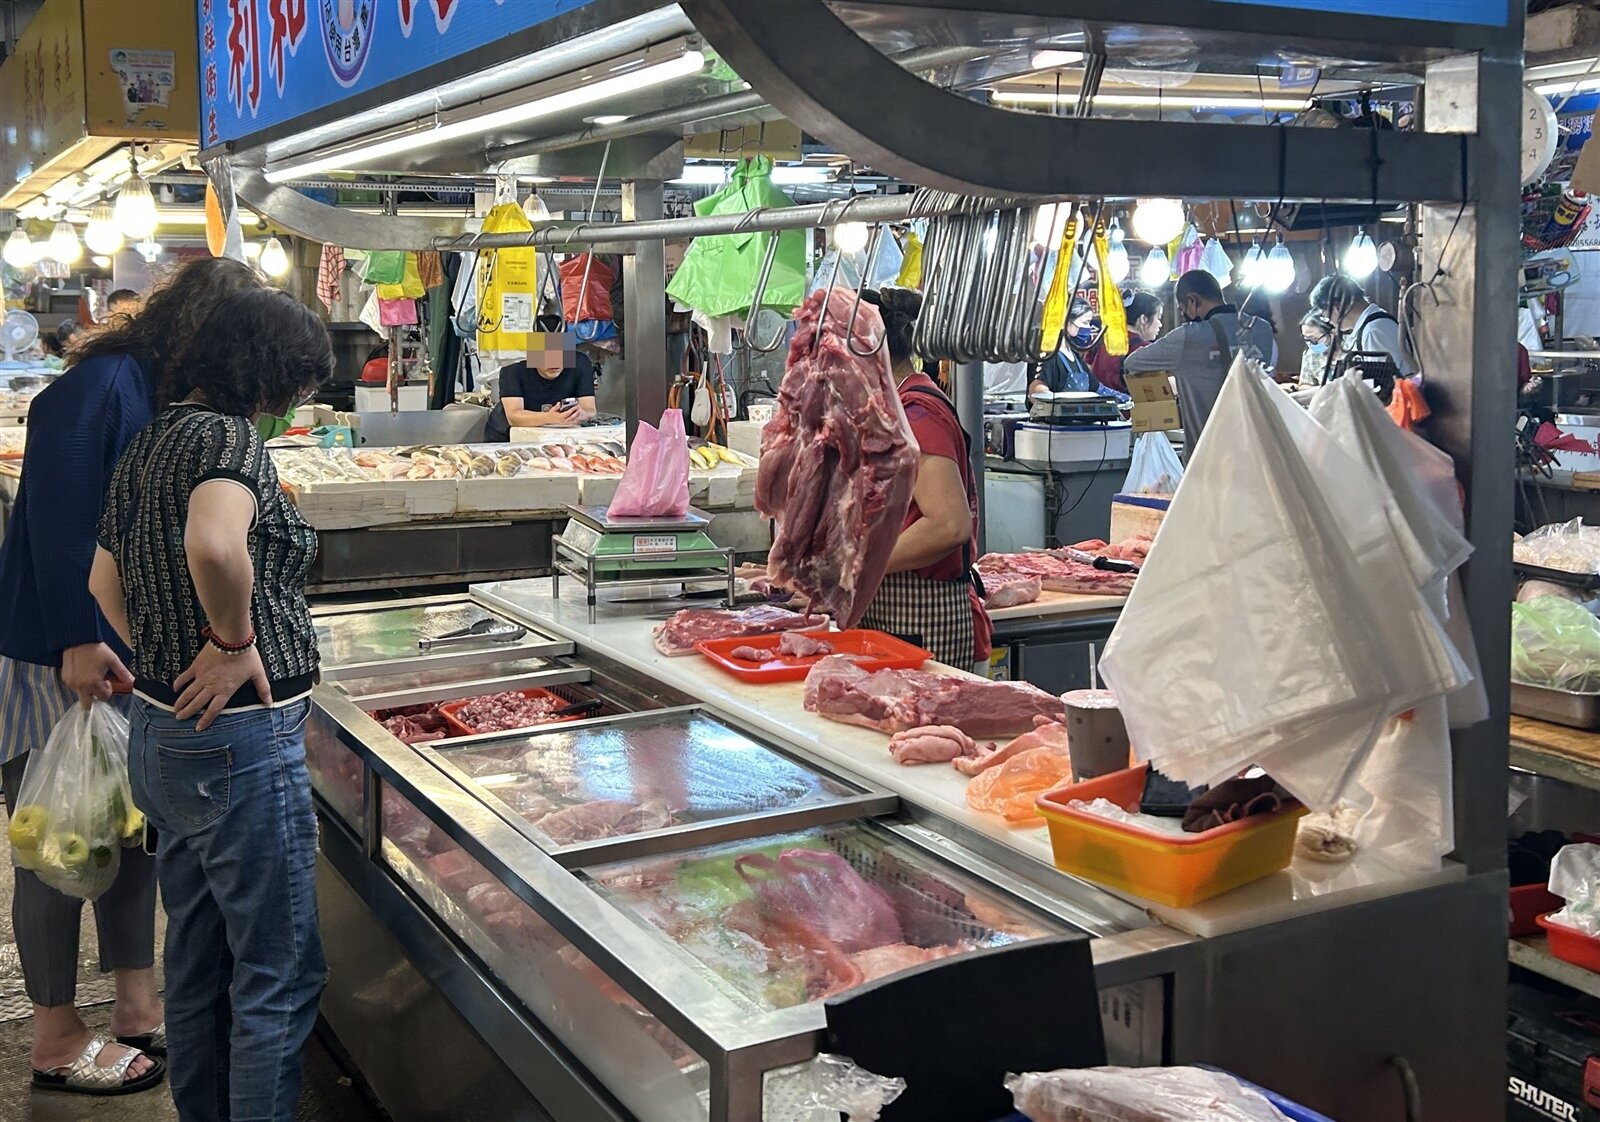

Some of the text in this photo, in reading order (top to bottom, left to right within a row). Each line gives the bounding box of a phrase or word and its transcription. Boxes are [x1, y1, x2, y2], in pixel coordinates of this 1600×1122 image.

[1529, 108, 1537, 120] 2
[1534, 128, 1543, 140] 3
[1529, 148, 1537, 160] 4
[1507, 1076, 1577, 1122] SHUTER
